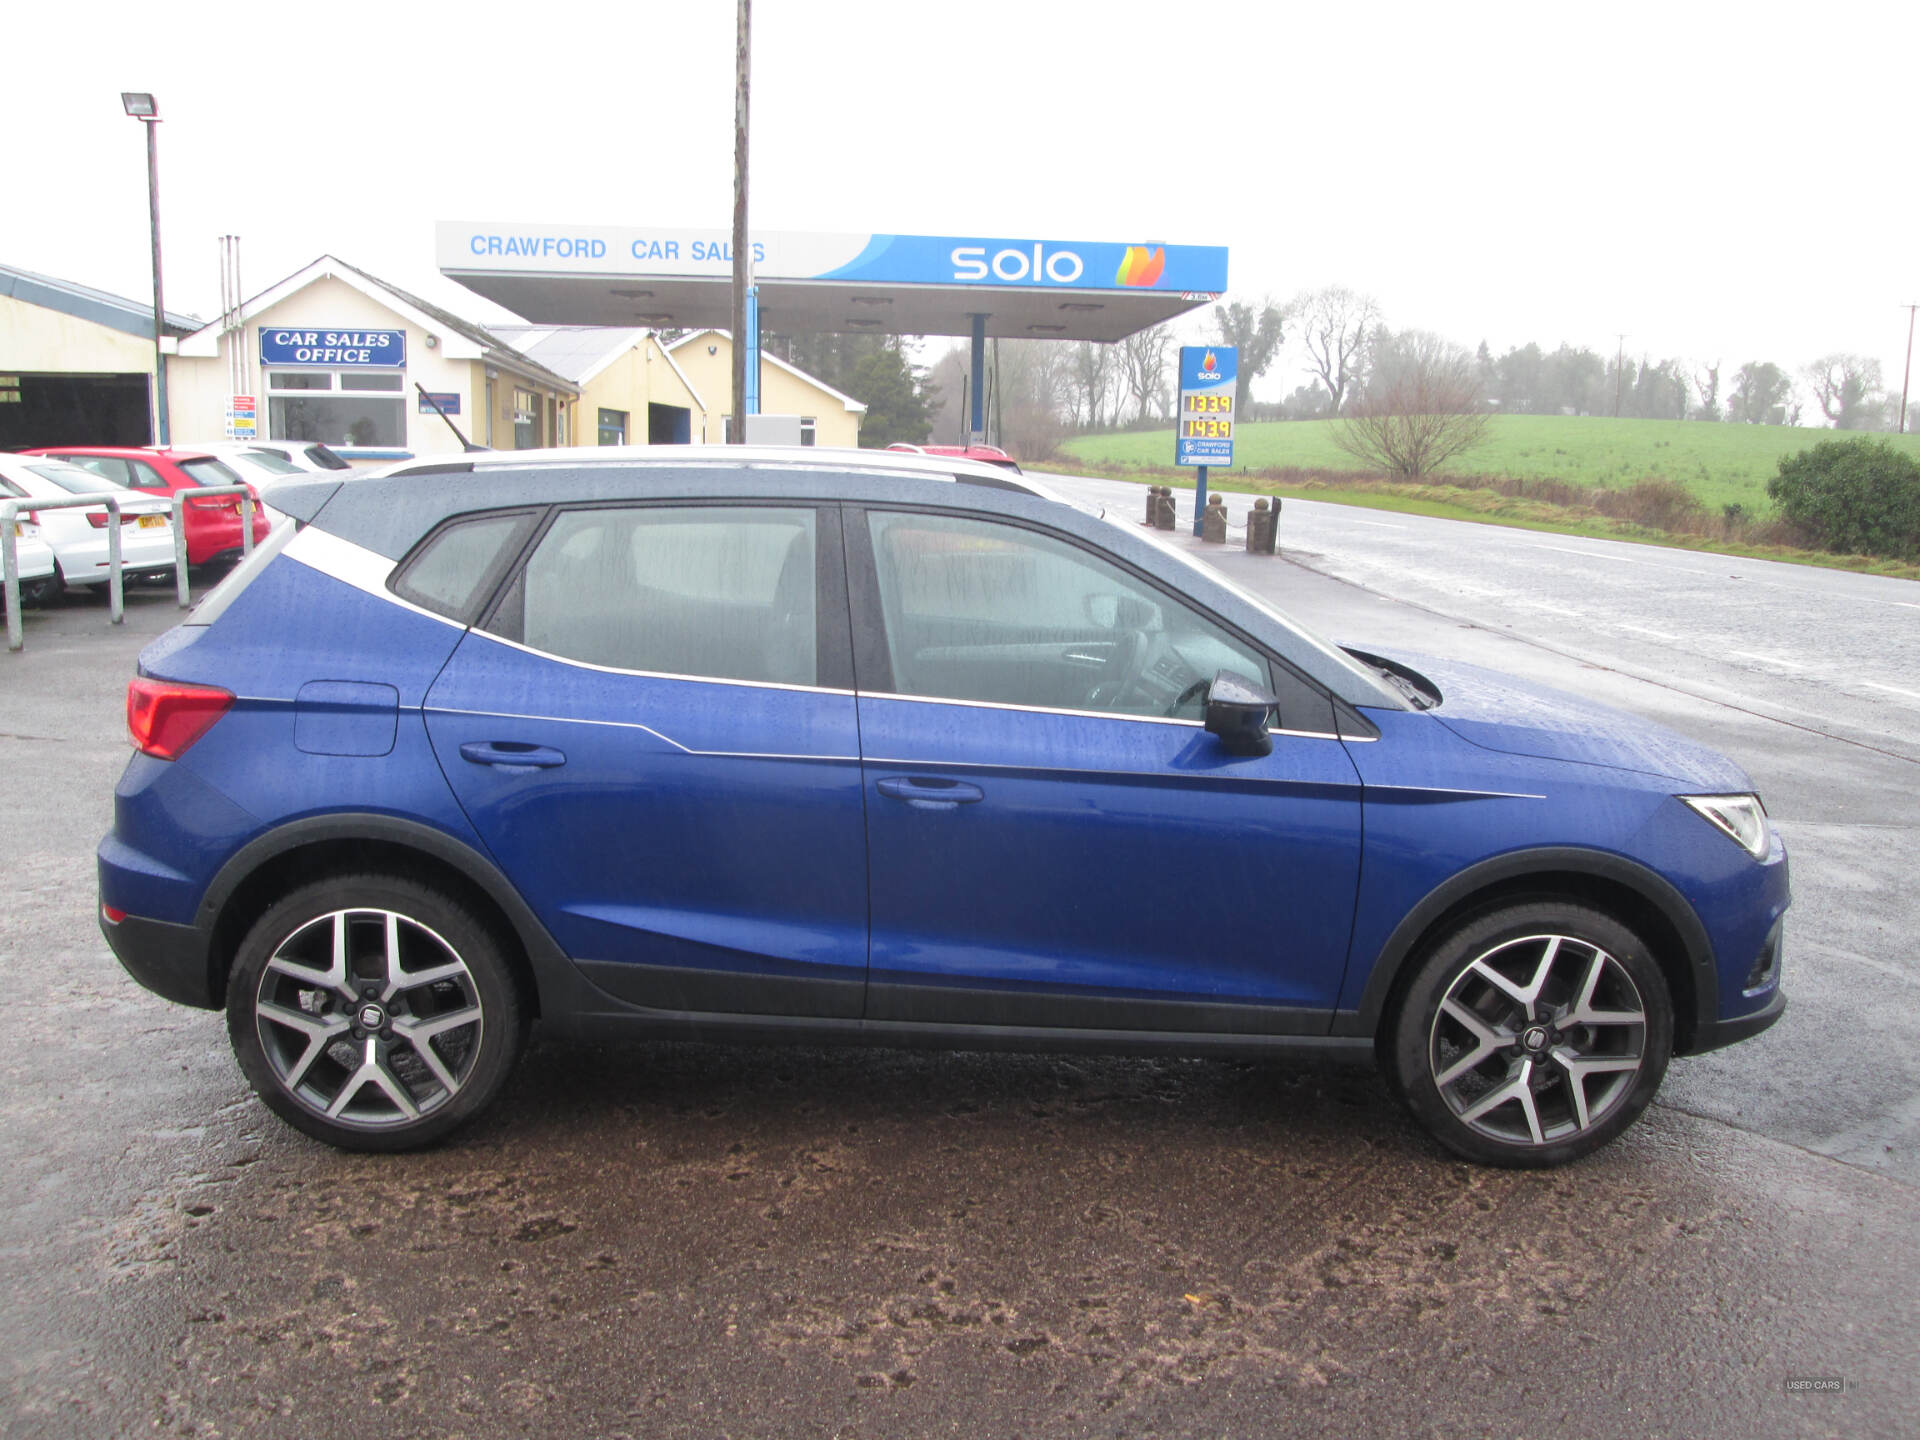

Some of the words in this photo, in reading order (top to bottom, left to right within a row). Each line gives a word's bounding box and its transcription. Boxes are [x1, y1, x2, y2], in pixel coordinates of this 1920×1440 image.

[470, 235, 606, 259] CRAWFORD
[631, 240, 679, 260] CAR
[691, 241, 765, 262] SALS
[951, 243, 1083, 283] solo
[275, 332, 319, 346] CAR
[324, 333, 390, 347] SALES
[295, 348, 371, 362] OFFICE
